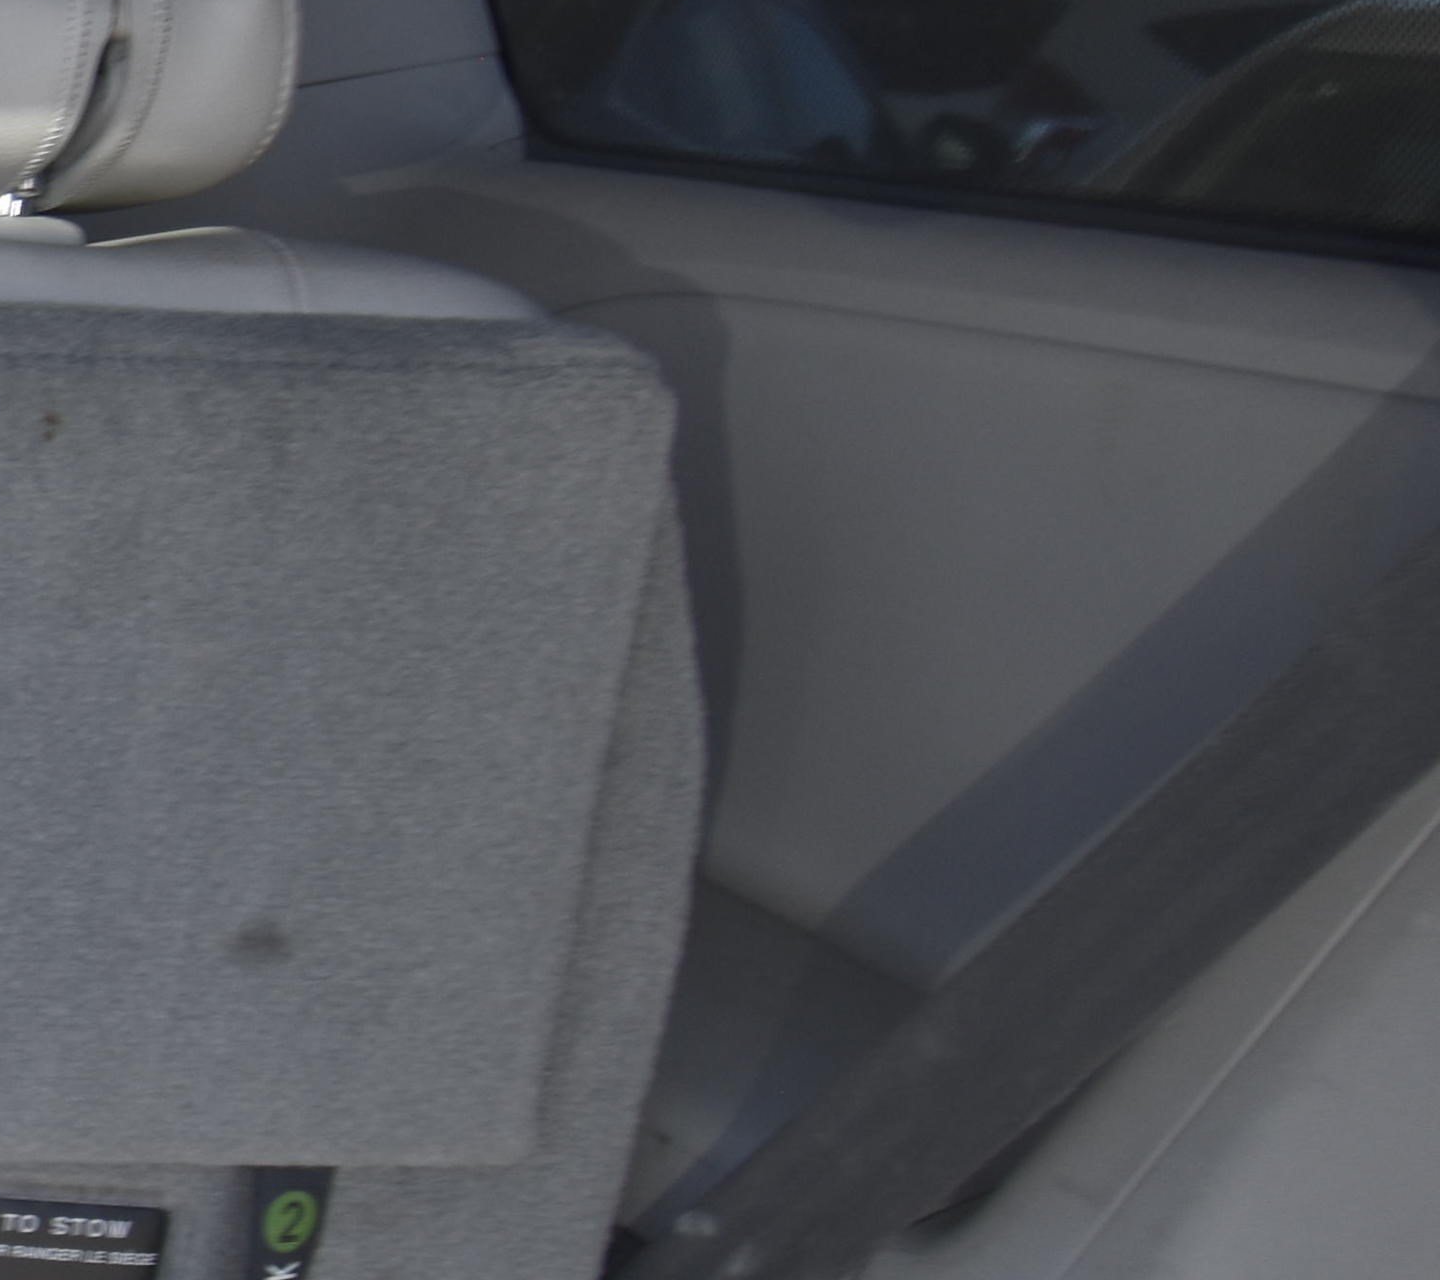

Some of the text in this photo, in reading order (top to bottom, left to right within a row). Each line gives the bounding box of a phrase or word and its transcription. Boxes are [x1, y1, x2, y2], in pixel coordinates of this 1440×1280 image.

[0, 1213, 133, 1239] TO STOW
[276, 1200, 305, 1244] 2
